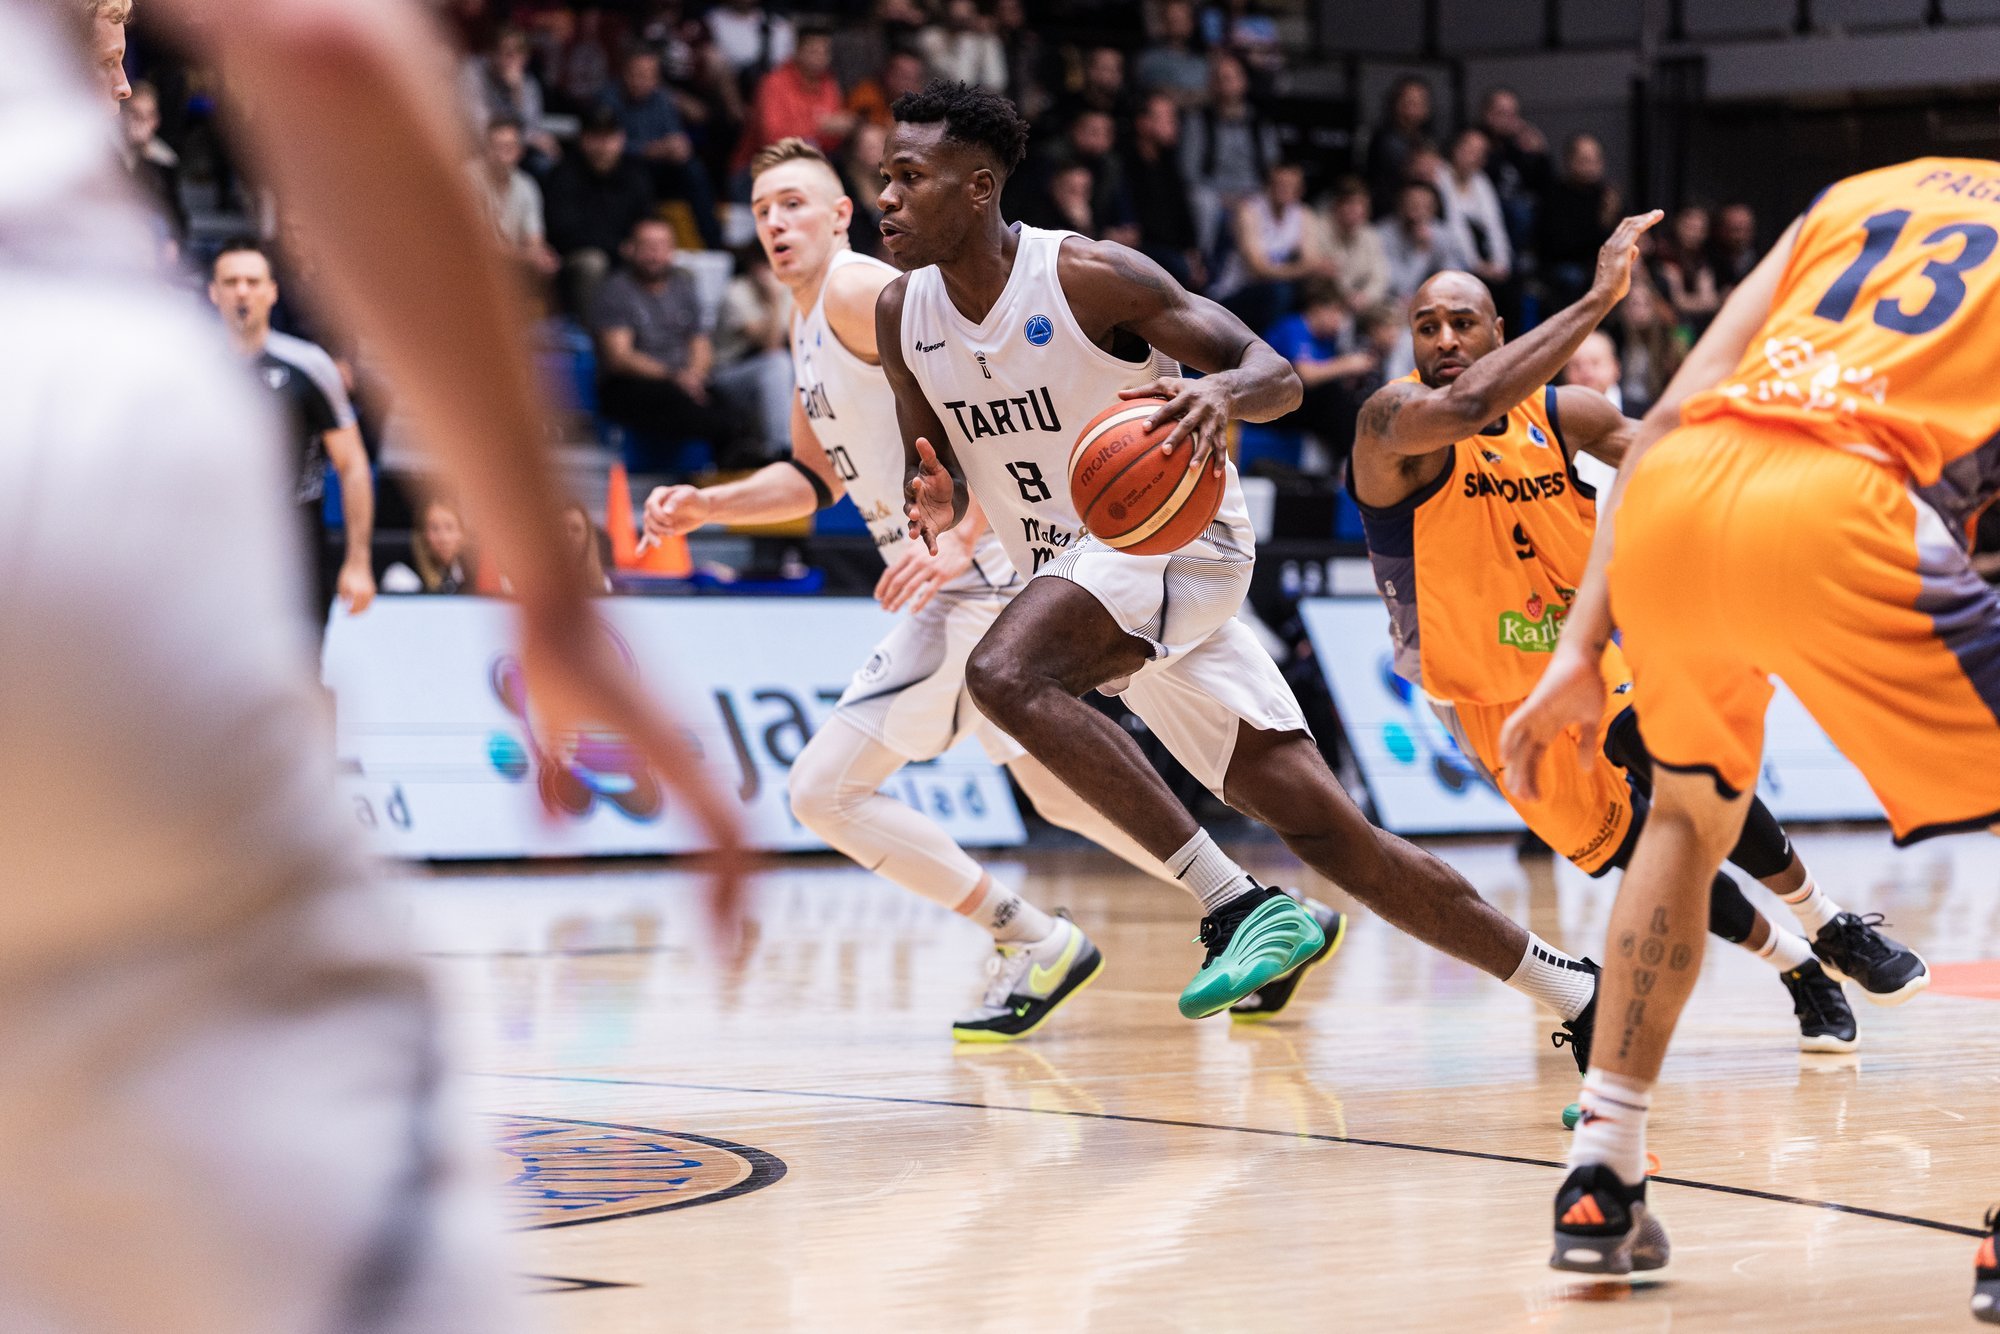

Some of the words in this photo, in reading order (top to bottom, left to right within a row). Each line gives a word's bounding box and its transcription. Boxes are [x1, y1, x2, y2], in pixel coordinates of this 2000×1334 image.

[1813, 208, 1999, 336] 13
[943, 386, 1062, 443] TARTU
[1005, 461, 1052, 503] 8
[1080, 432, 1135, 487] molten
[1020, 517, 1071, 547] Maks
